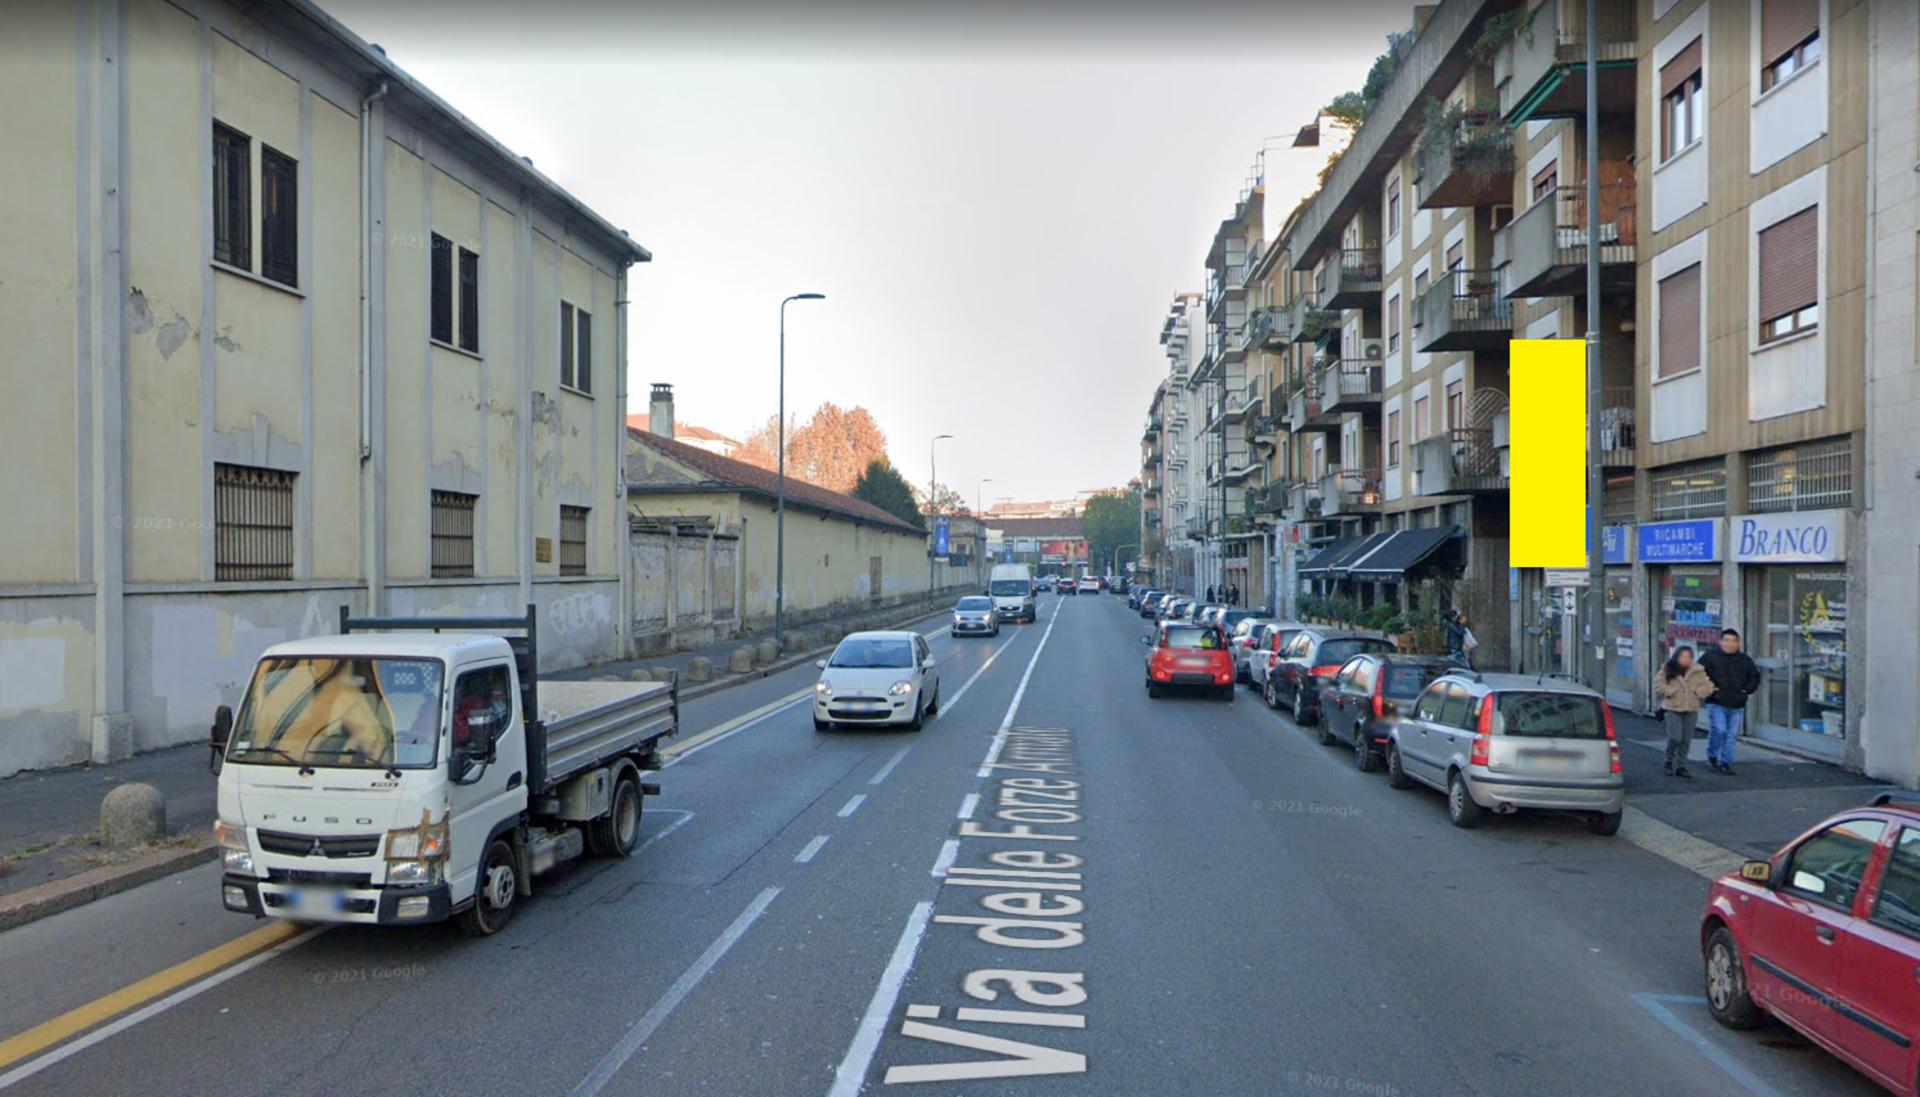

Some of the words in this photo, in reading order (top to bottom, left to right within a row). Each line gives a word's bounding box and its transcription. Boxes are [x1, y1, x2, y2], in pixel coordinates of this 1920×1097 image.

[1654, 527, 1696, 541] RICAMBI
[1646, 542, 1705, 557] MULTIMARCHE
[263, 813, 373, 825] FUSO
